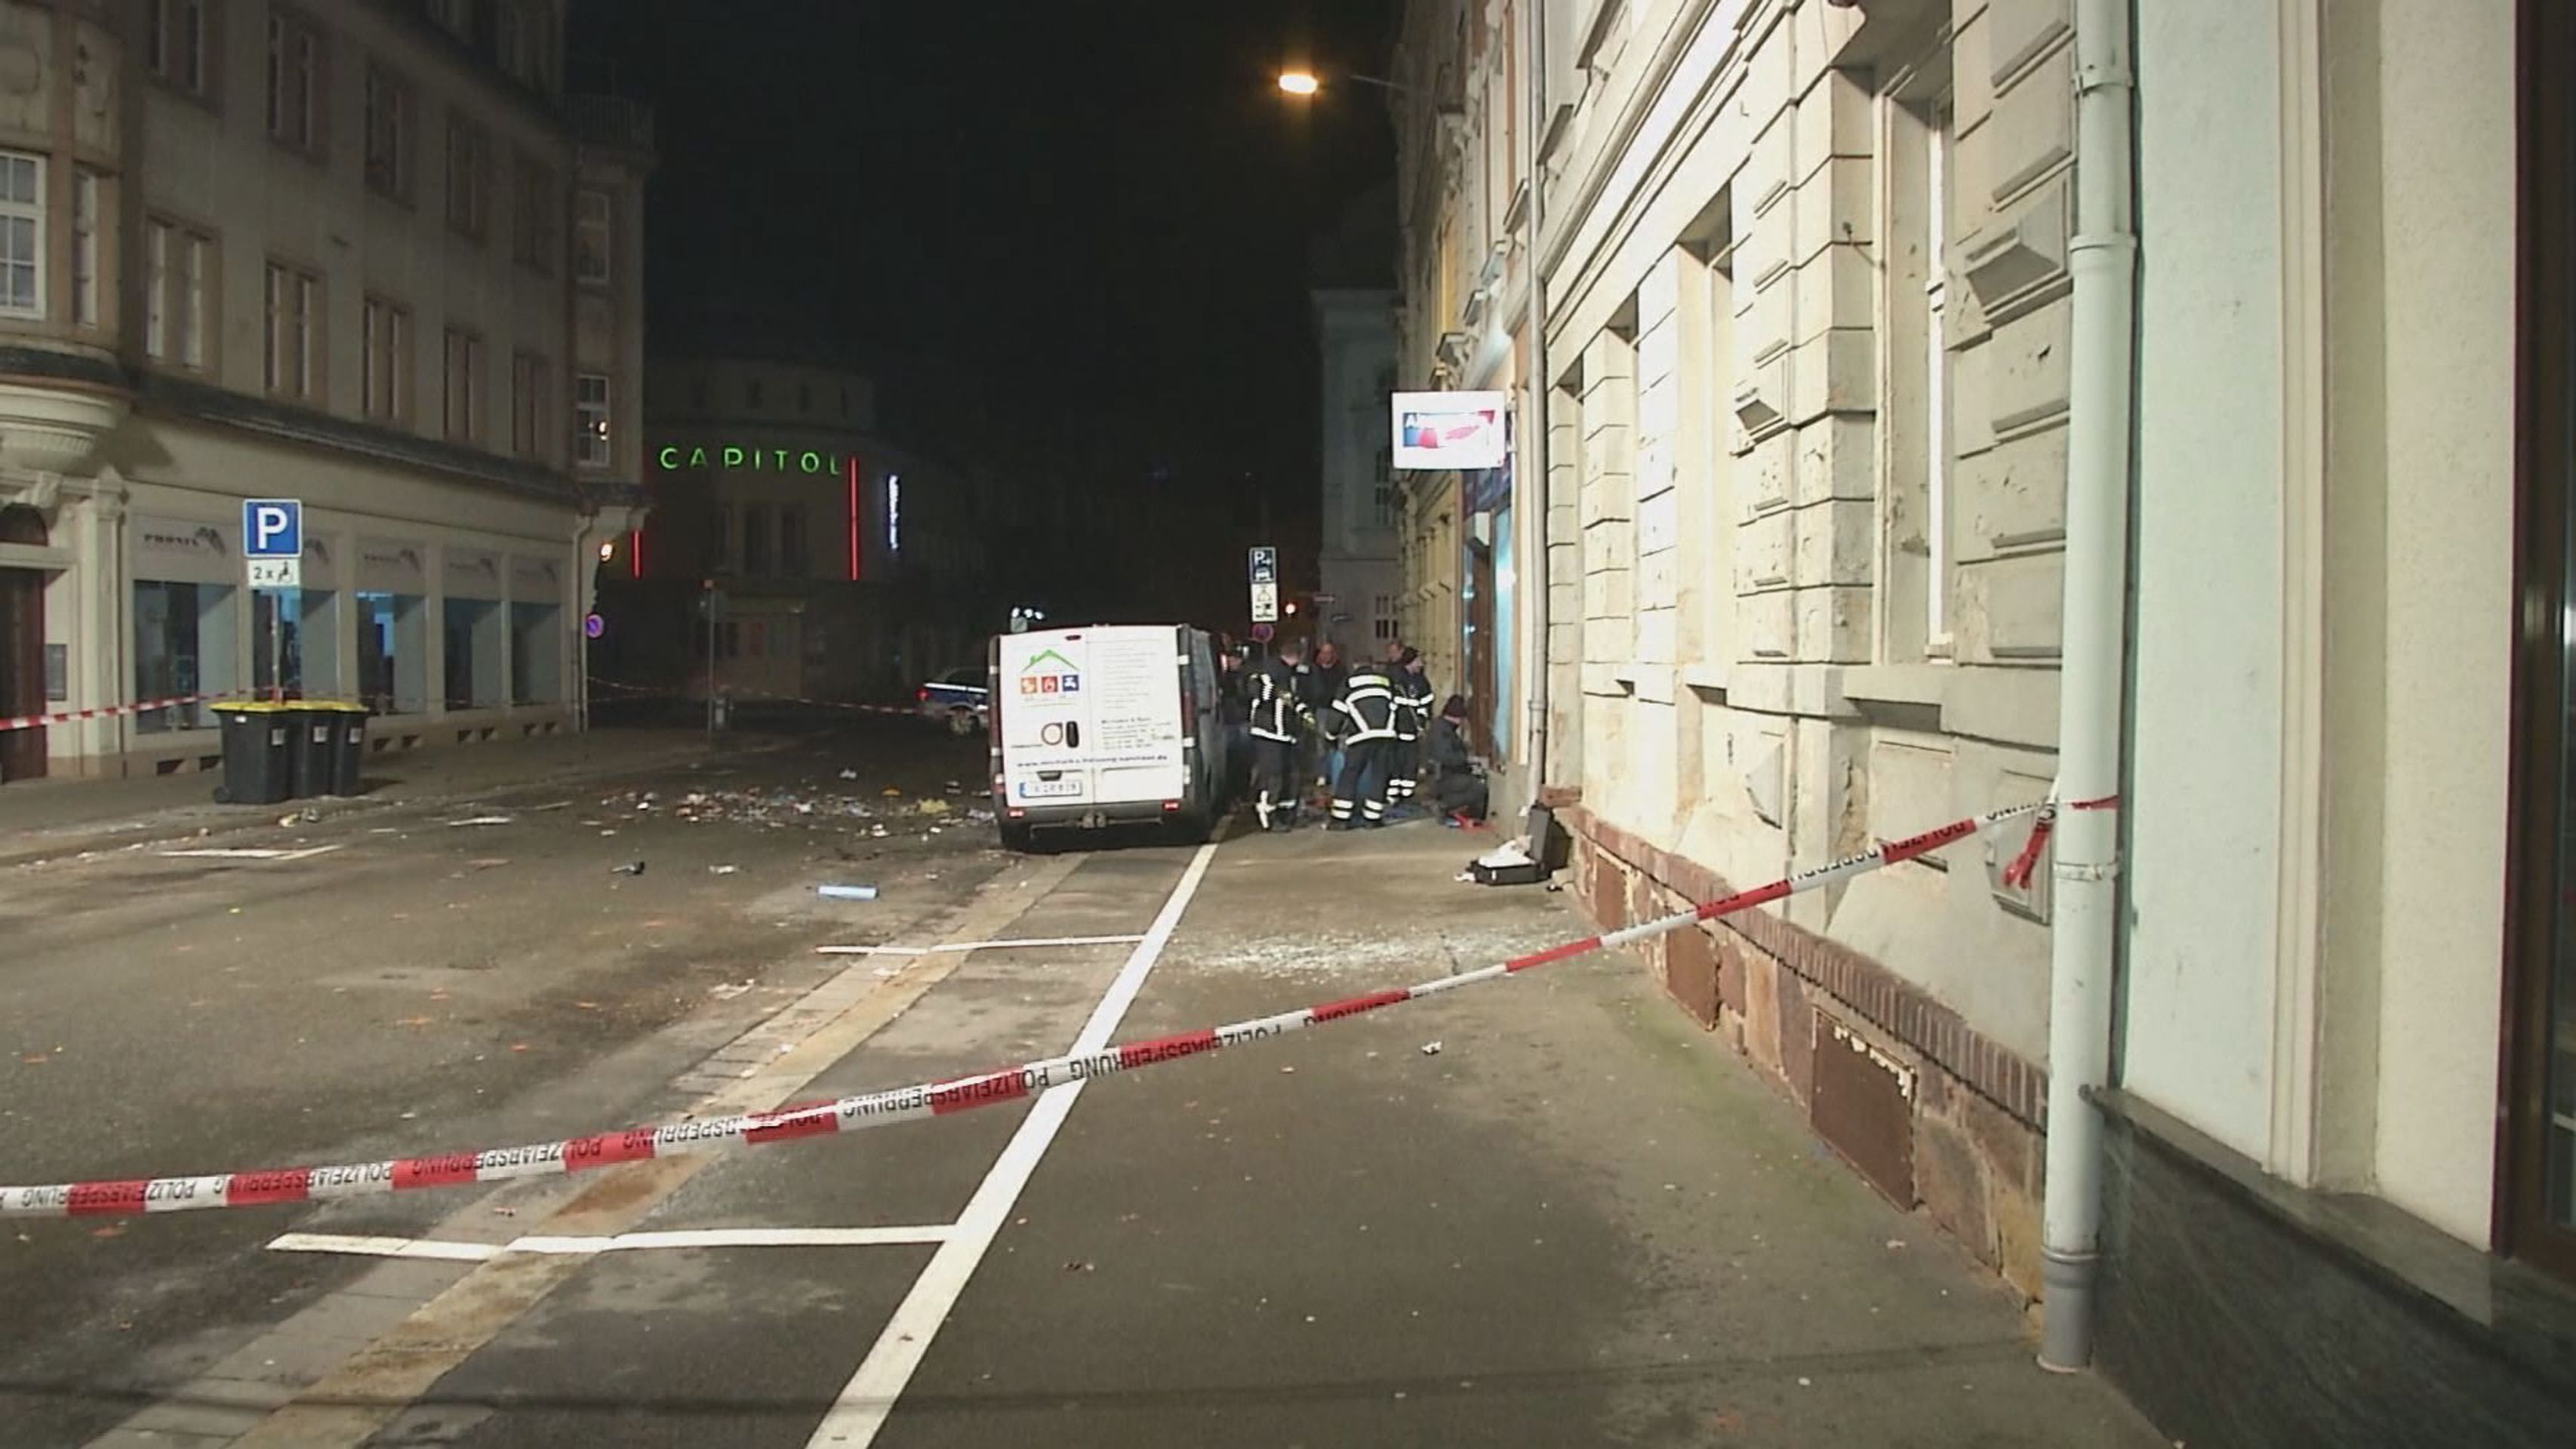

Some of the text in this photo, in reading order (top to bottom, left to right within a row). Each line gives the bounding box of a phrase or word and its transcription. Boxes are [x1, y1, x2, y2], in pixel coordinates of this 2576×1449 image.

[660, 448, 839, 475] CAPITOL
[257, 507, 288, 549] P
[254, 567, 262, 580] 2
